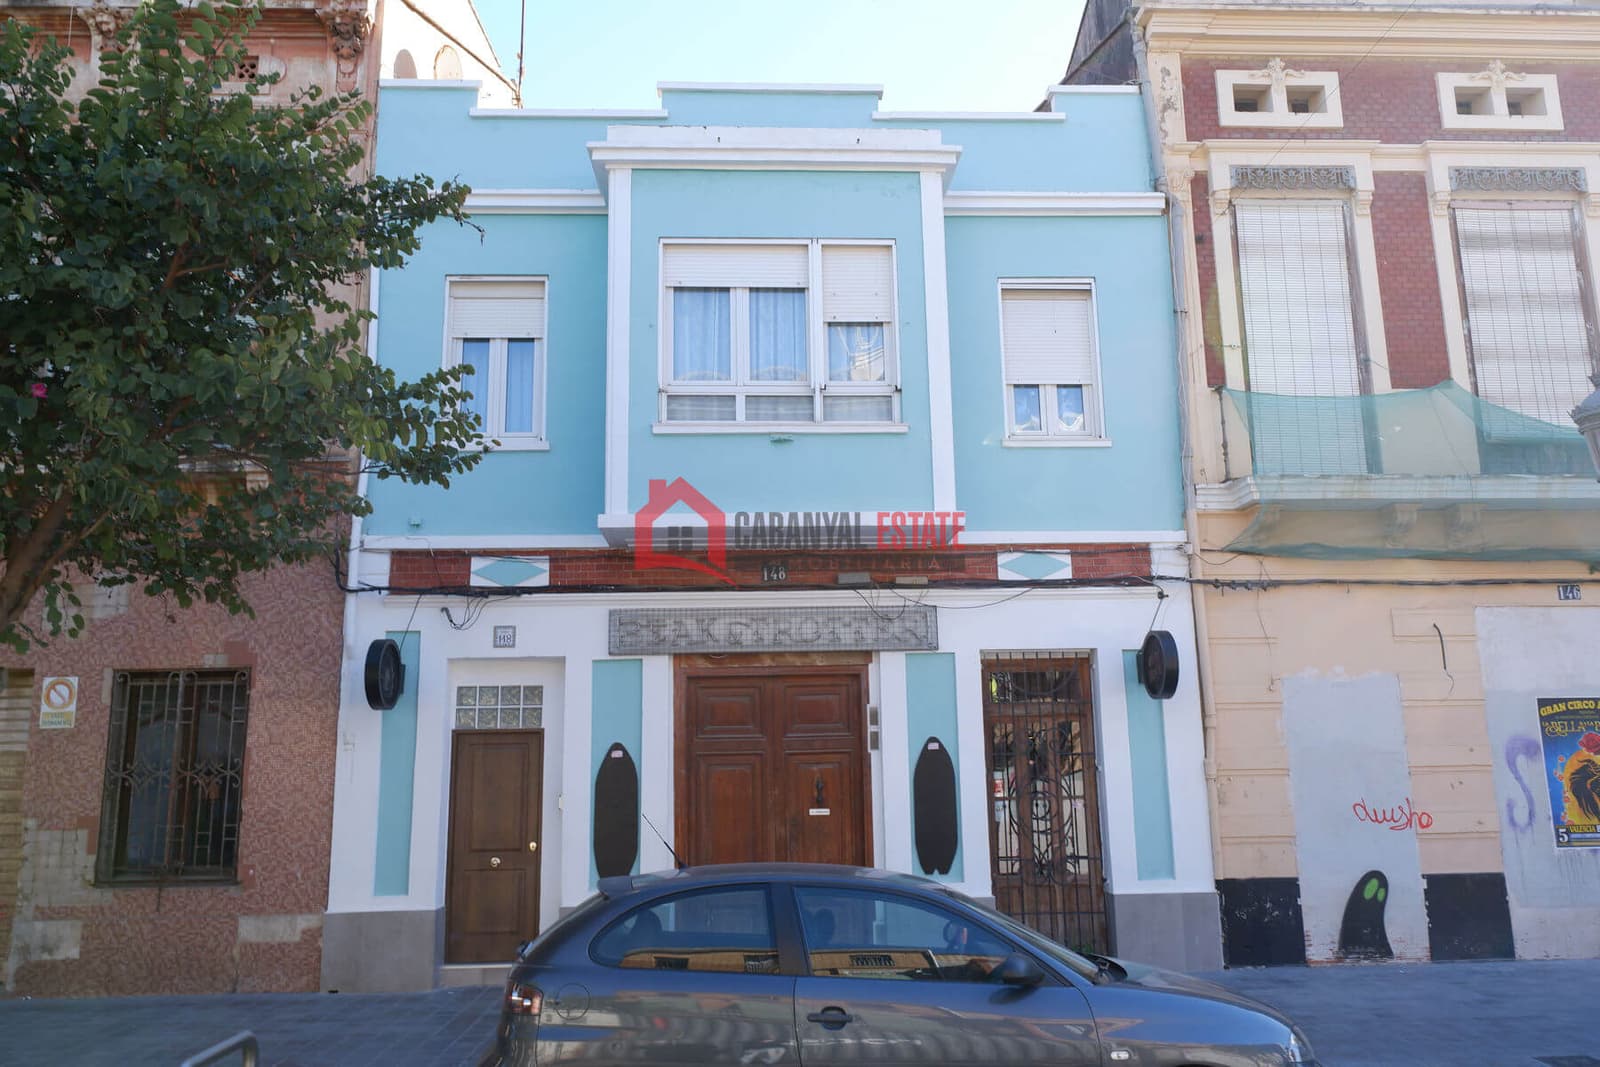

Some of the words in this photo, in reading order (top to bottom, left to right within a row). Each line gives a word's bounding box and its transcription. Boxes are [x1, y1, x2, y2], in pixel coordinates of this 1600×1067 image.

[763, 566, 786, 581] 148
[1559, 585, 1581, 600] 146
[1540, 703, 1566, 716] GRAN
[1567, 700, 1595, 710] CIRCO
[1558, 828, 1569, 843] 5
